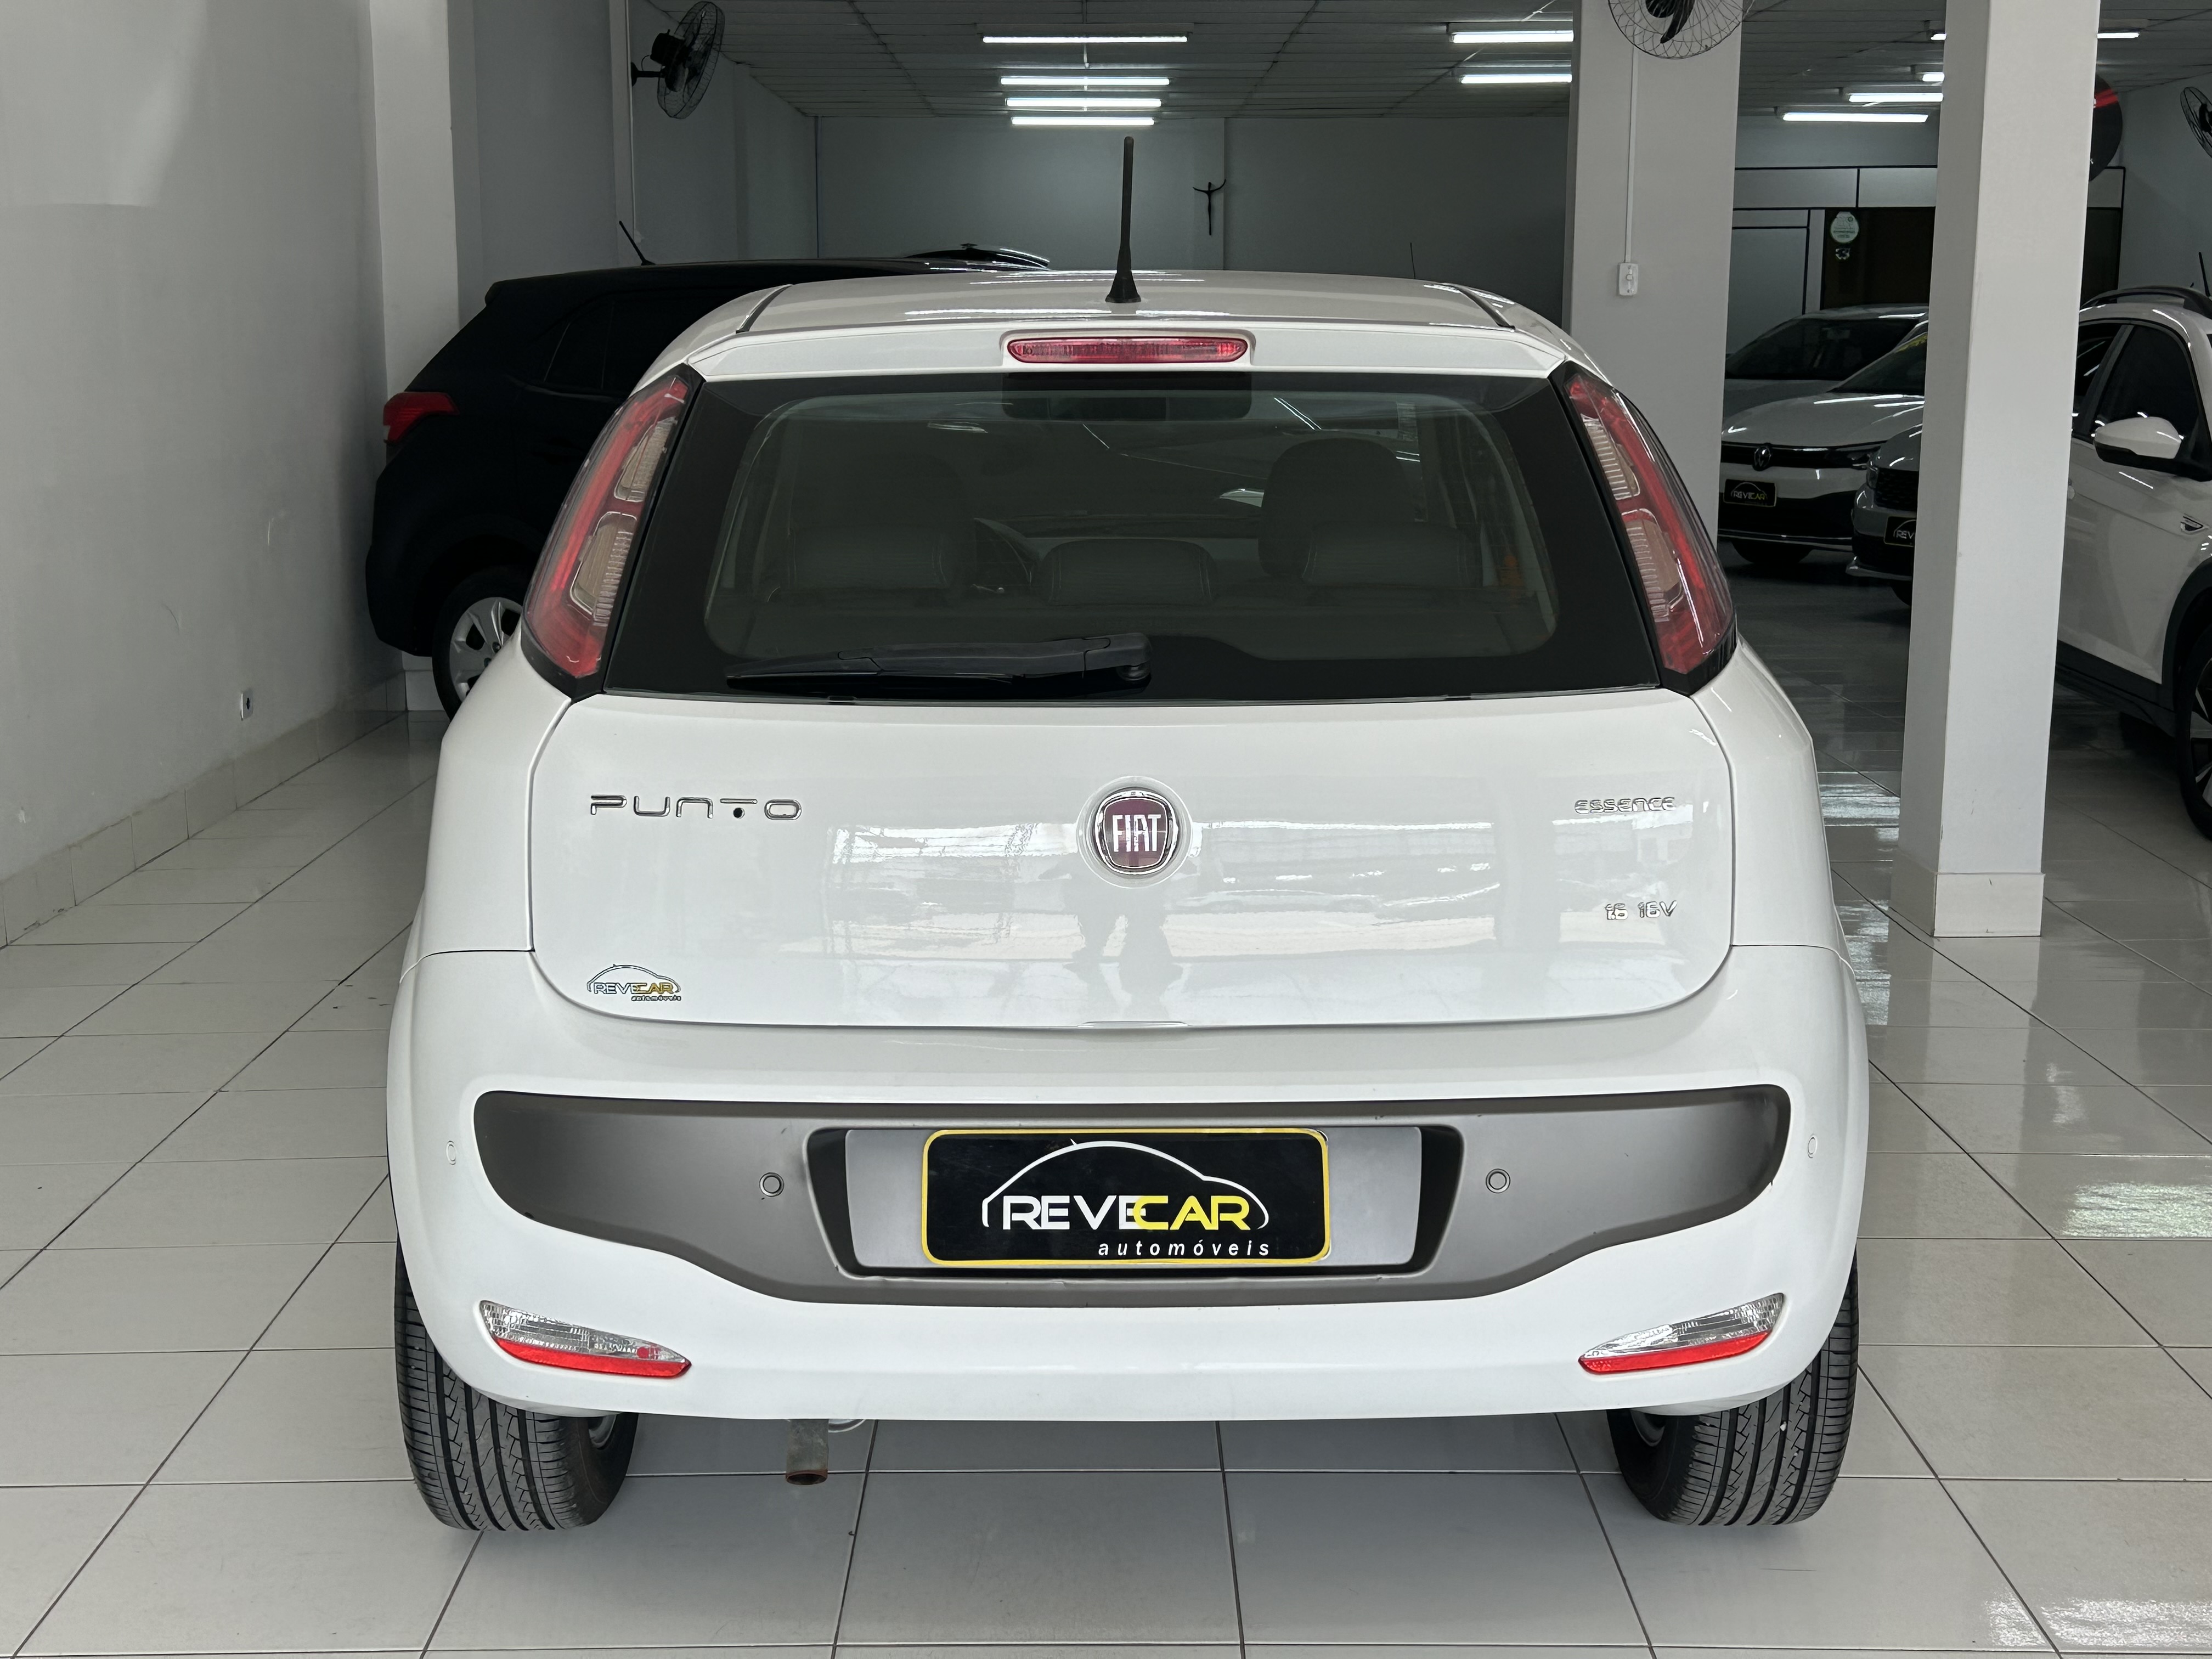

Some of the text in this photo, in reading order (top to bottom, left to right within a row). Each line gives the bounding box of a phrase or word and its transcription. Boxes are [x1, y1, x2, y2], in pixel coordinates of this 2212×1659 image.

[1896, 529, 1915, 539] REV
[590, 794, 802, 821] PUNTO
[1574, 797, 1676, 814] ESSENCE
[1112, 814, 1161, 852] FIAT
[1637, 900, 1678, 918] 16V
[593, 982, 674, 995] REVECAR
[1003, 1195, 1251, 1231] REVECAR
[1098, 1239, 1269, 1256] automóveis
